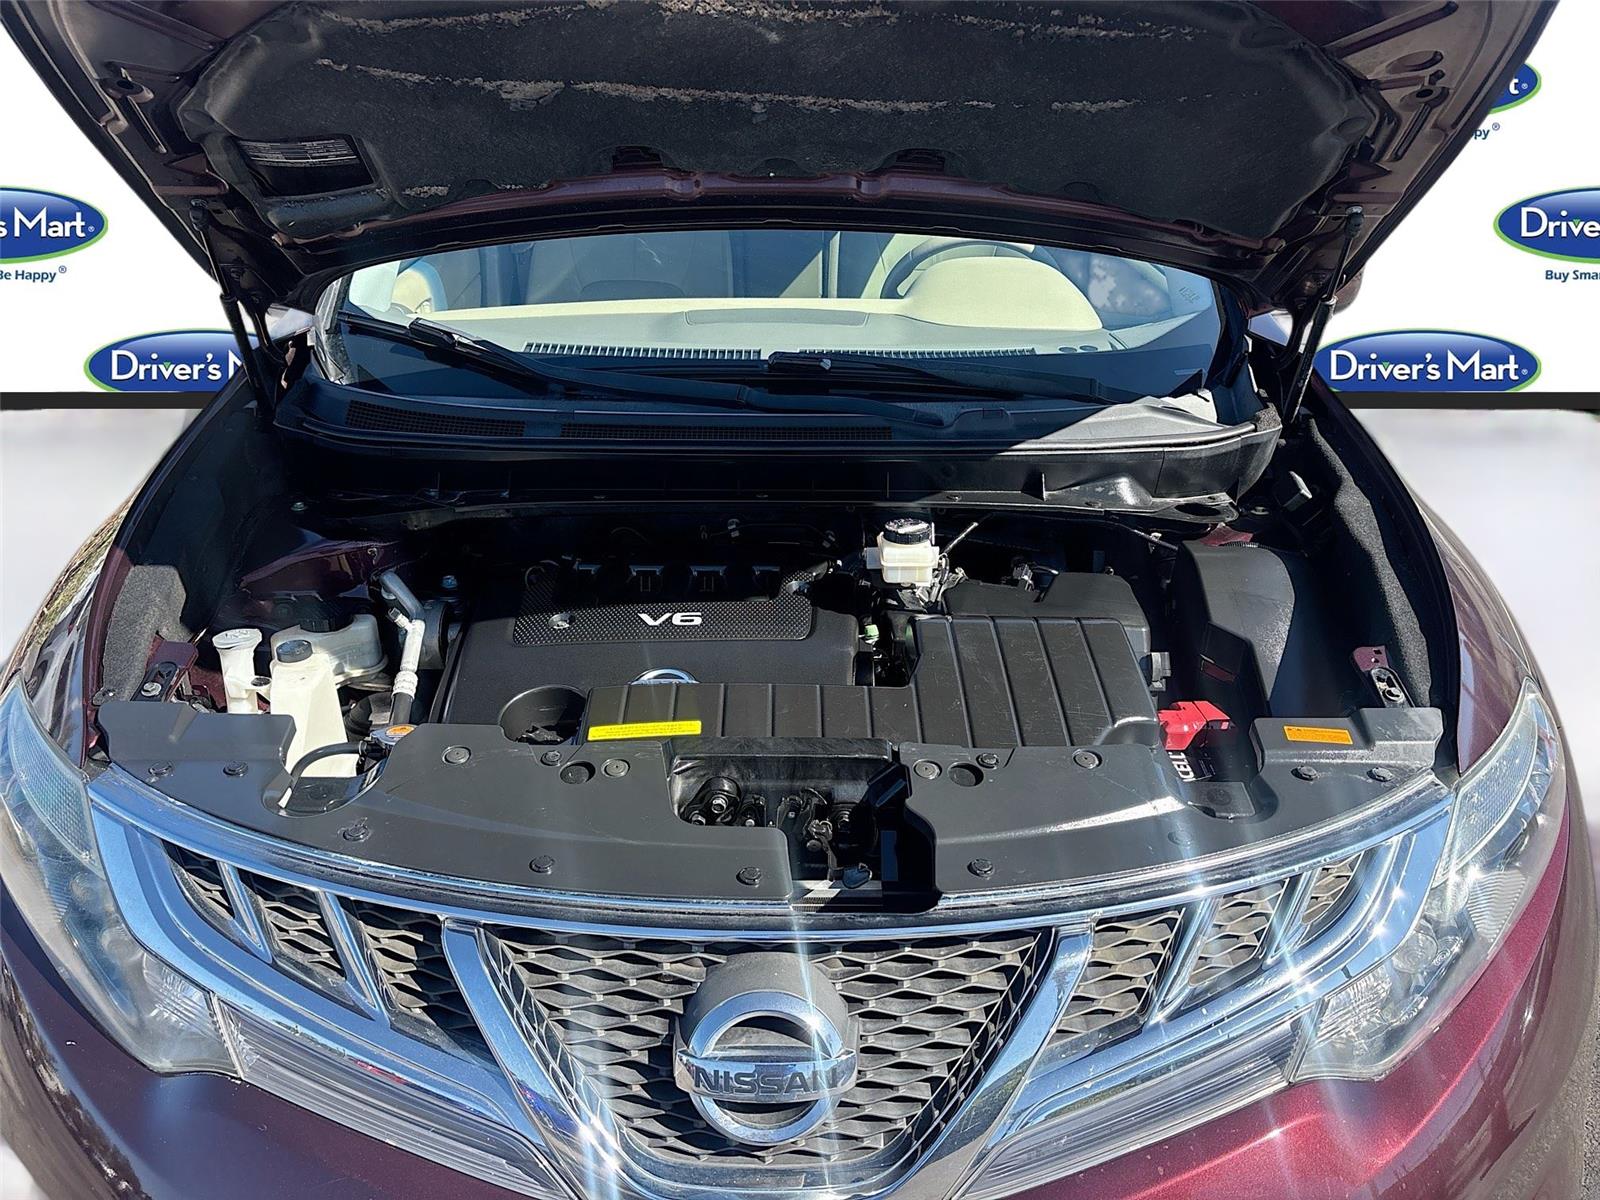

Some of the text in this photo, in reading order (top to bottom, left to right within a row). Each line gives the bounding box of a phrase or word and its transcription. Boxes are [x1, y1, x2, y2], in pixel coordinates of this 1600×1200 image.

[13, 206, 86, 238] Mart
[14, 269, 57, 283] Happy
[1545, 269, 1570, 283] Buy
[111, 349, 222, 381] Driver's
[1330, 349, 1519, 381] Driver's Mart
[637, 611, 703, 627] V6
[693, 1065, 838, 1094] NISSAN
